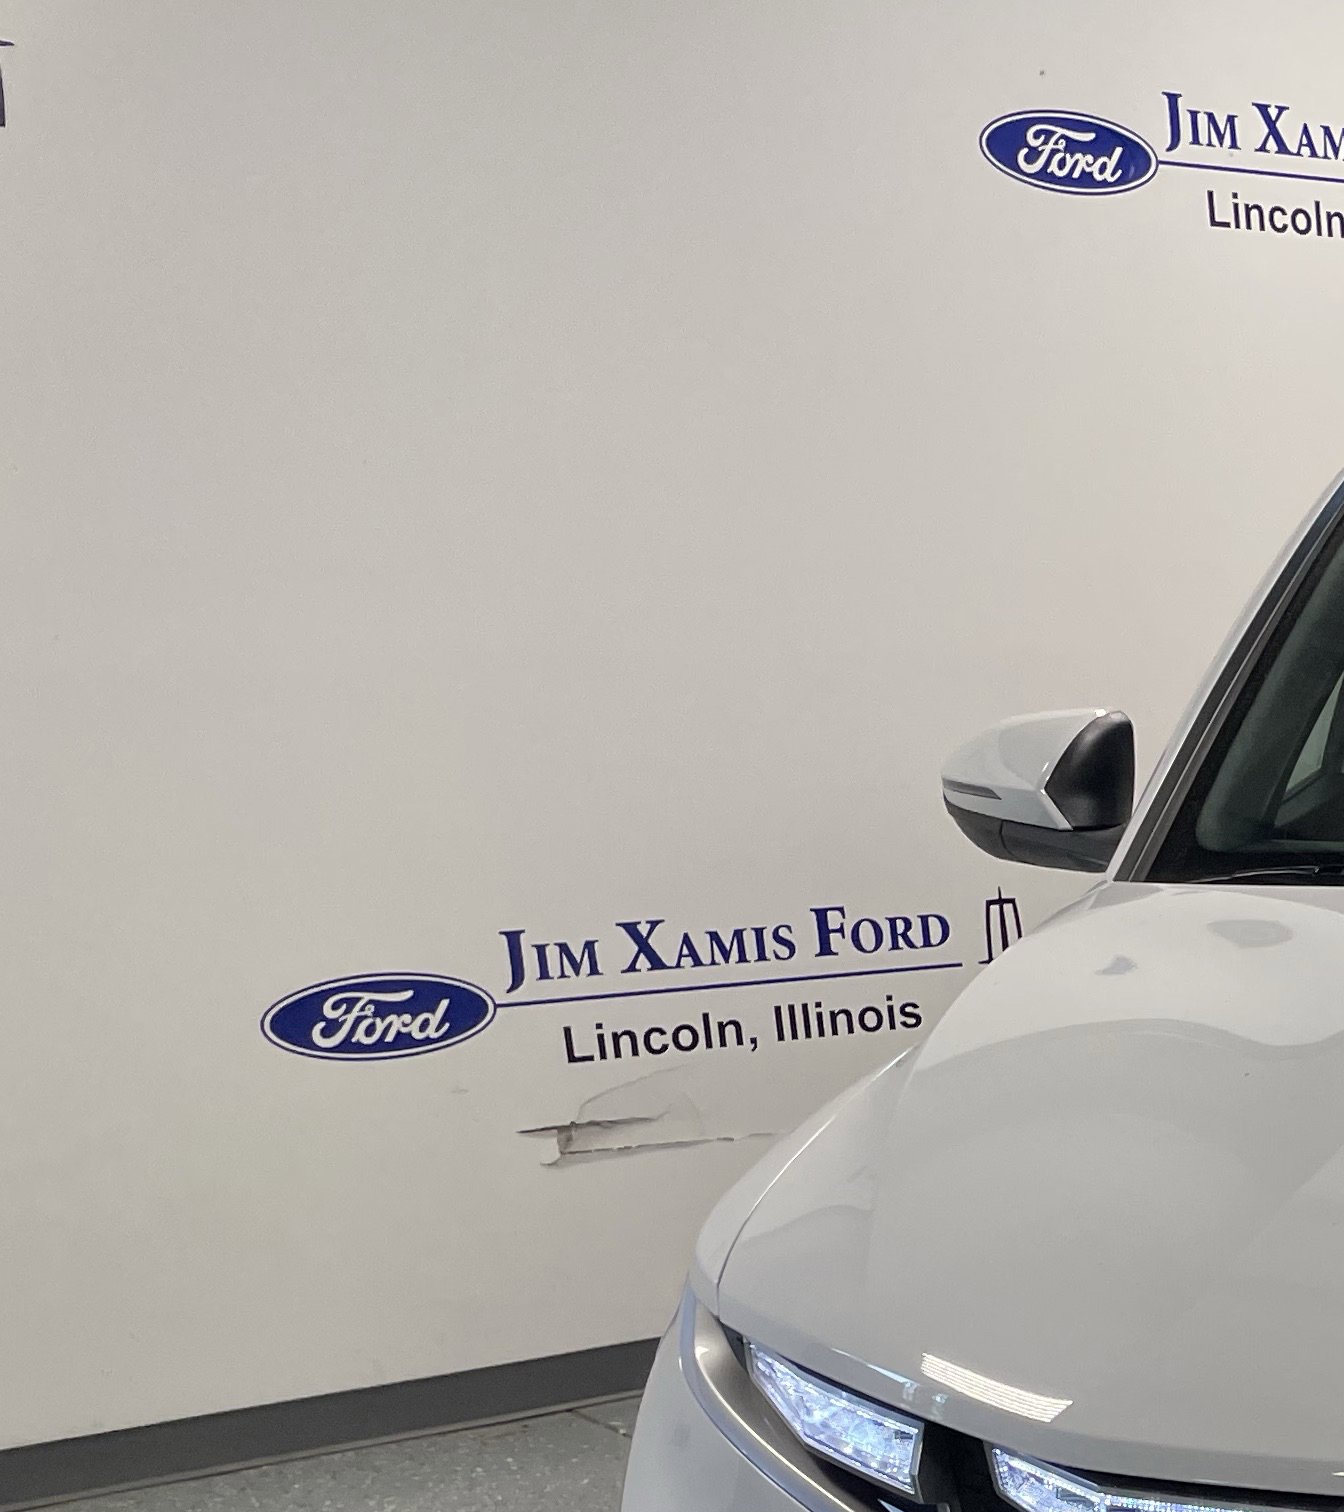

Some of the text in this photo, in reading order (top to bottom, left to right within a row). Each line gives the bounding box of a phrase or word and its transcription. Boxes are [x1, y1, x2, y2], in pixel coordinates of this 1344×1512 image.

[1016, 123, 1124, 186] Ford
[312, 989, 451, 1049] Ford
[562, 993, 924, 1064] Lincoln, Illinois
